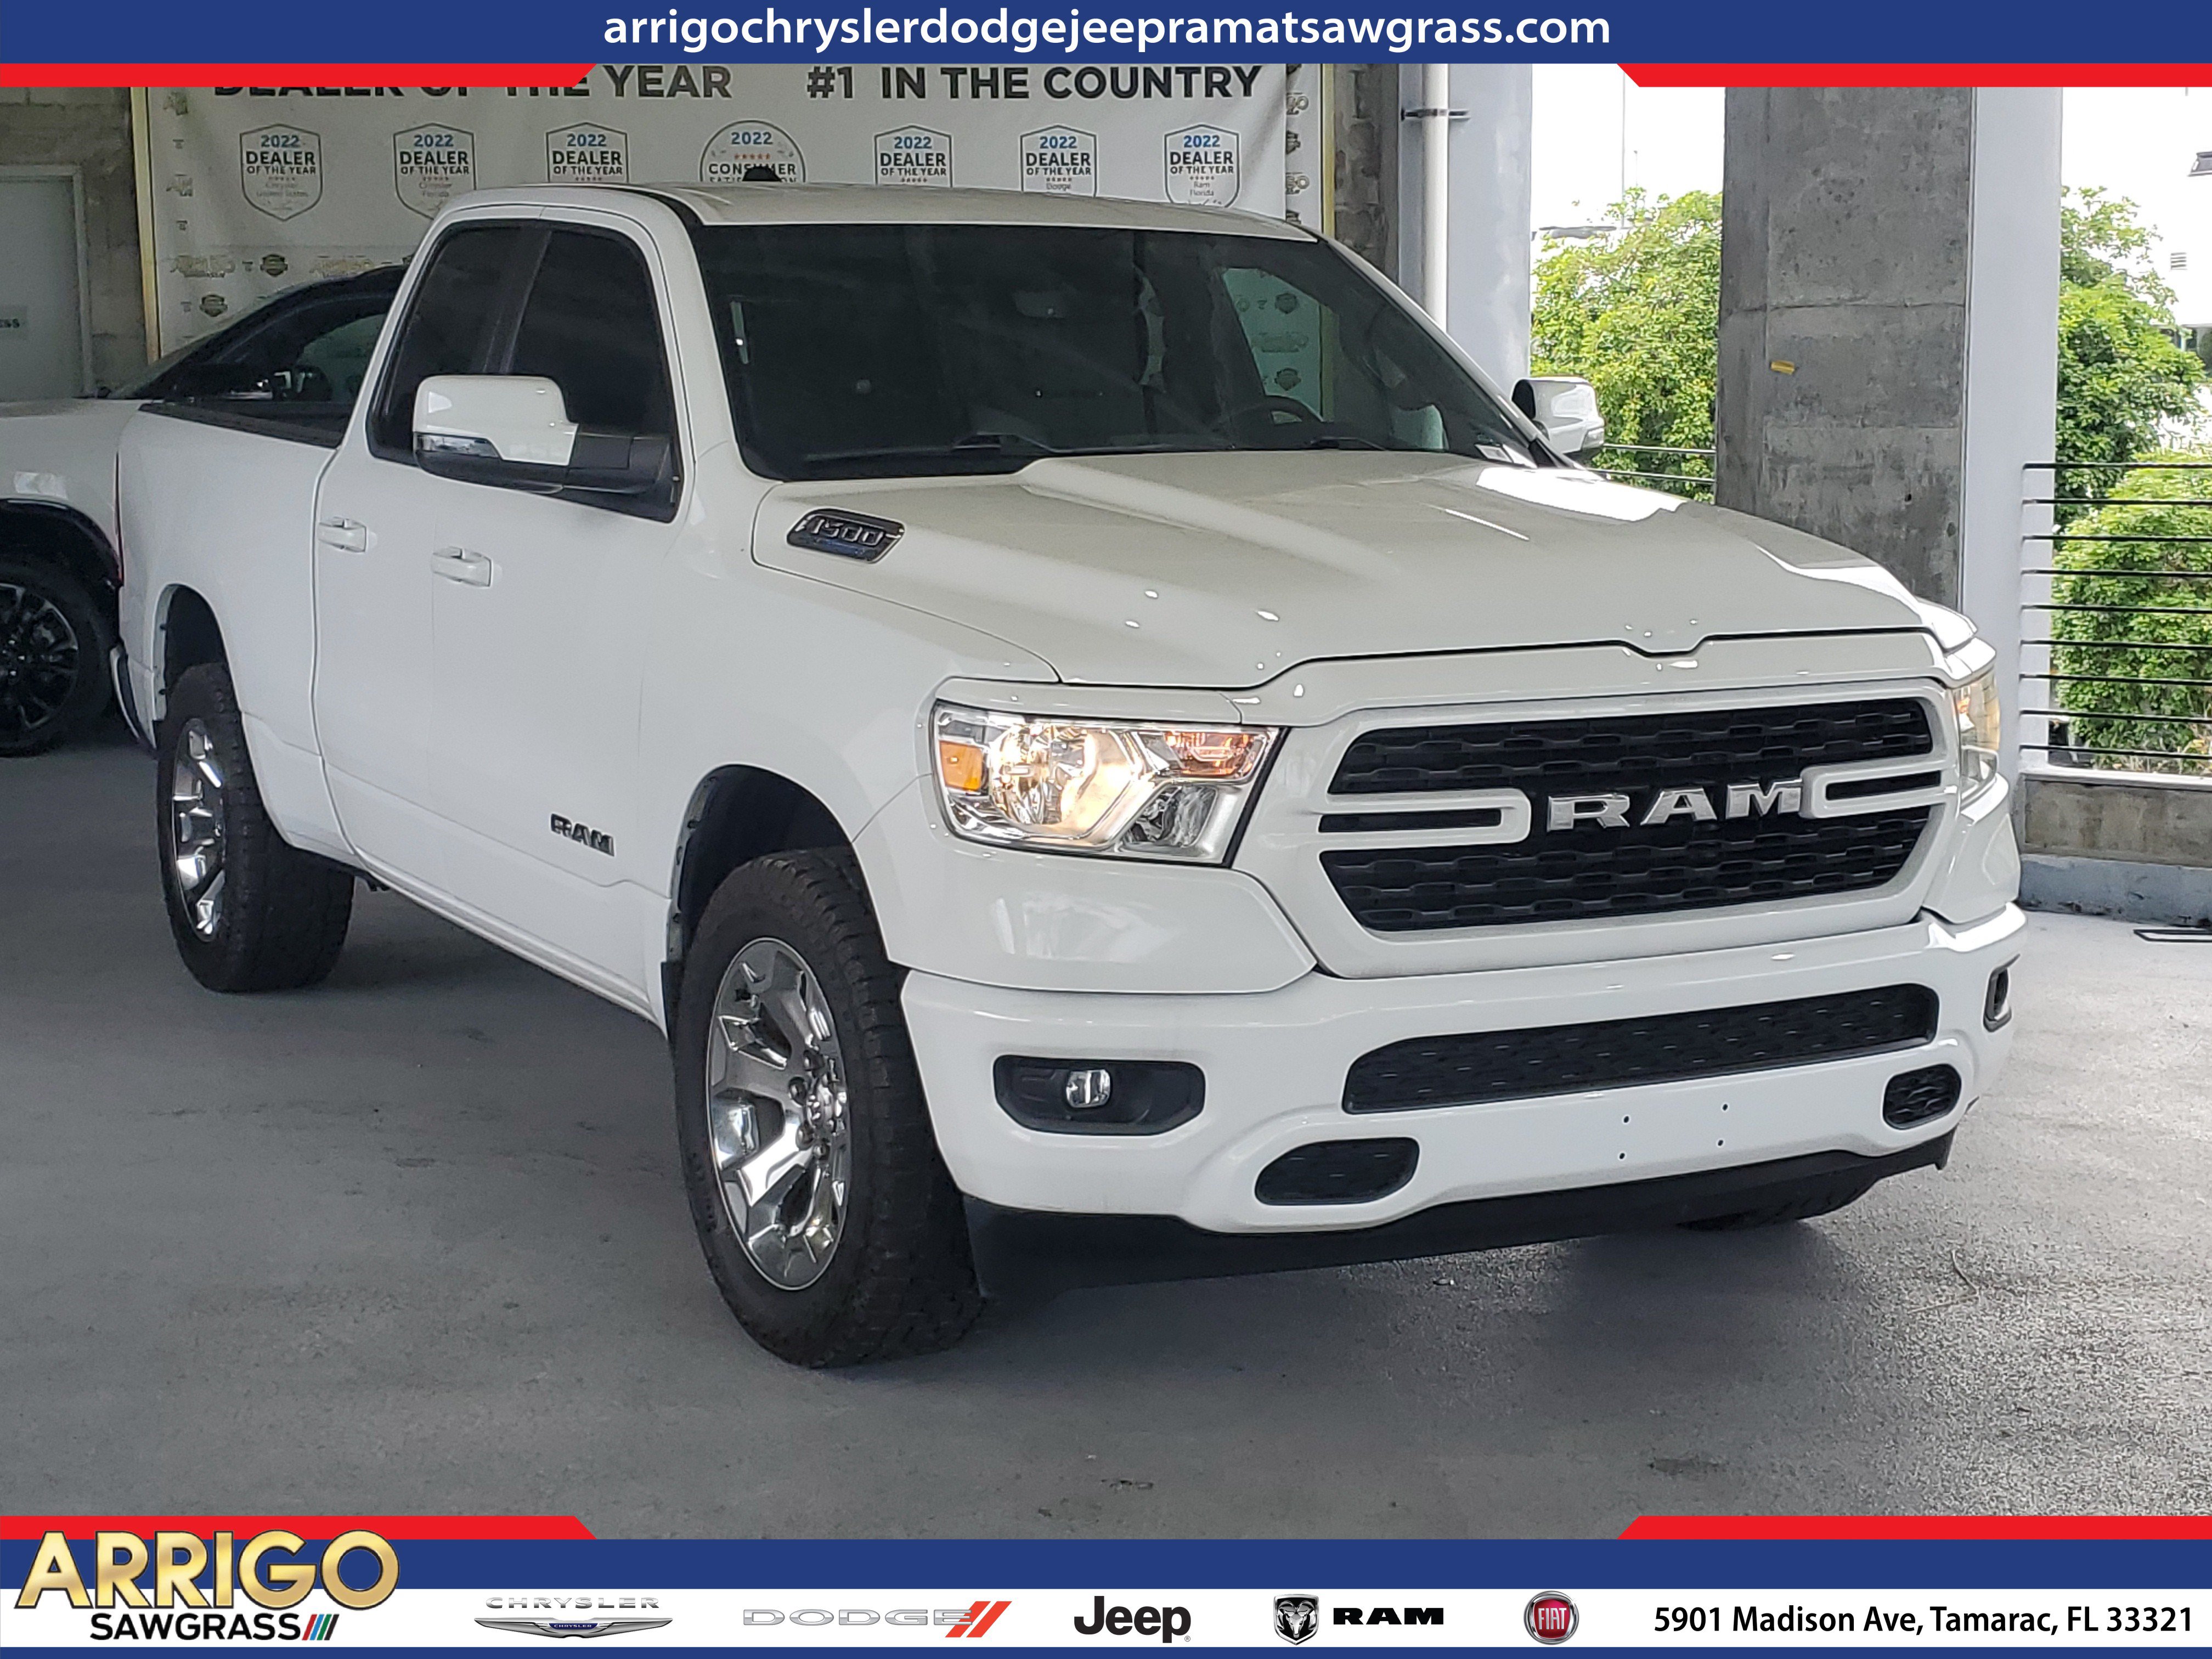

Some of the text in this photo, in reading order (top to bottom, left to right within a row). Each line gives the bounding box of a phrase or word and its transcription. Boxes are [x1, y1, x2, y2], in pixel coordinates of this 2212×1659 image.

[602, 65, 732, 98] YEAR
[807, 65, 1263, 99] #1 IN THE COUNTRY
[261, 135, 301, 148] 2022
[414, 134, 454, 147] 2022
[567, 133, 606, 146] 2022
[731, 132, 774, 145] 2022
[894, 136, 932, 149] 2022
[1040, 136, 1077, 149] 2022
[1184, 135, 1220, 148] 2022
[246, 151, 315, 165] DEALER
[400, 151, 469, 165] DEALER
[552, 150, 623, 165] DEALER
[881, 153, 946, 166] DEALER
[1026, 153, 1091, 166] DEALER
[1170, 151, 1233, 165] DEALER
[247, 166, 317, 174] OF THE YEAR
[400, 166, 470, 174] OF THE YEAR
[554, 166, 623, 174] OF THE YEAR
[881, 167, 947, 176] OF THE YEAR
[1170, 166, 1234, 174] OF THE YEAR
[1546, 779, 1803, 833] RAM
[551, 813, 615, 857] RAM
